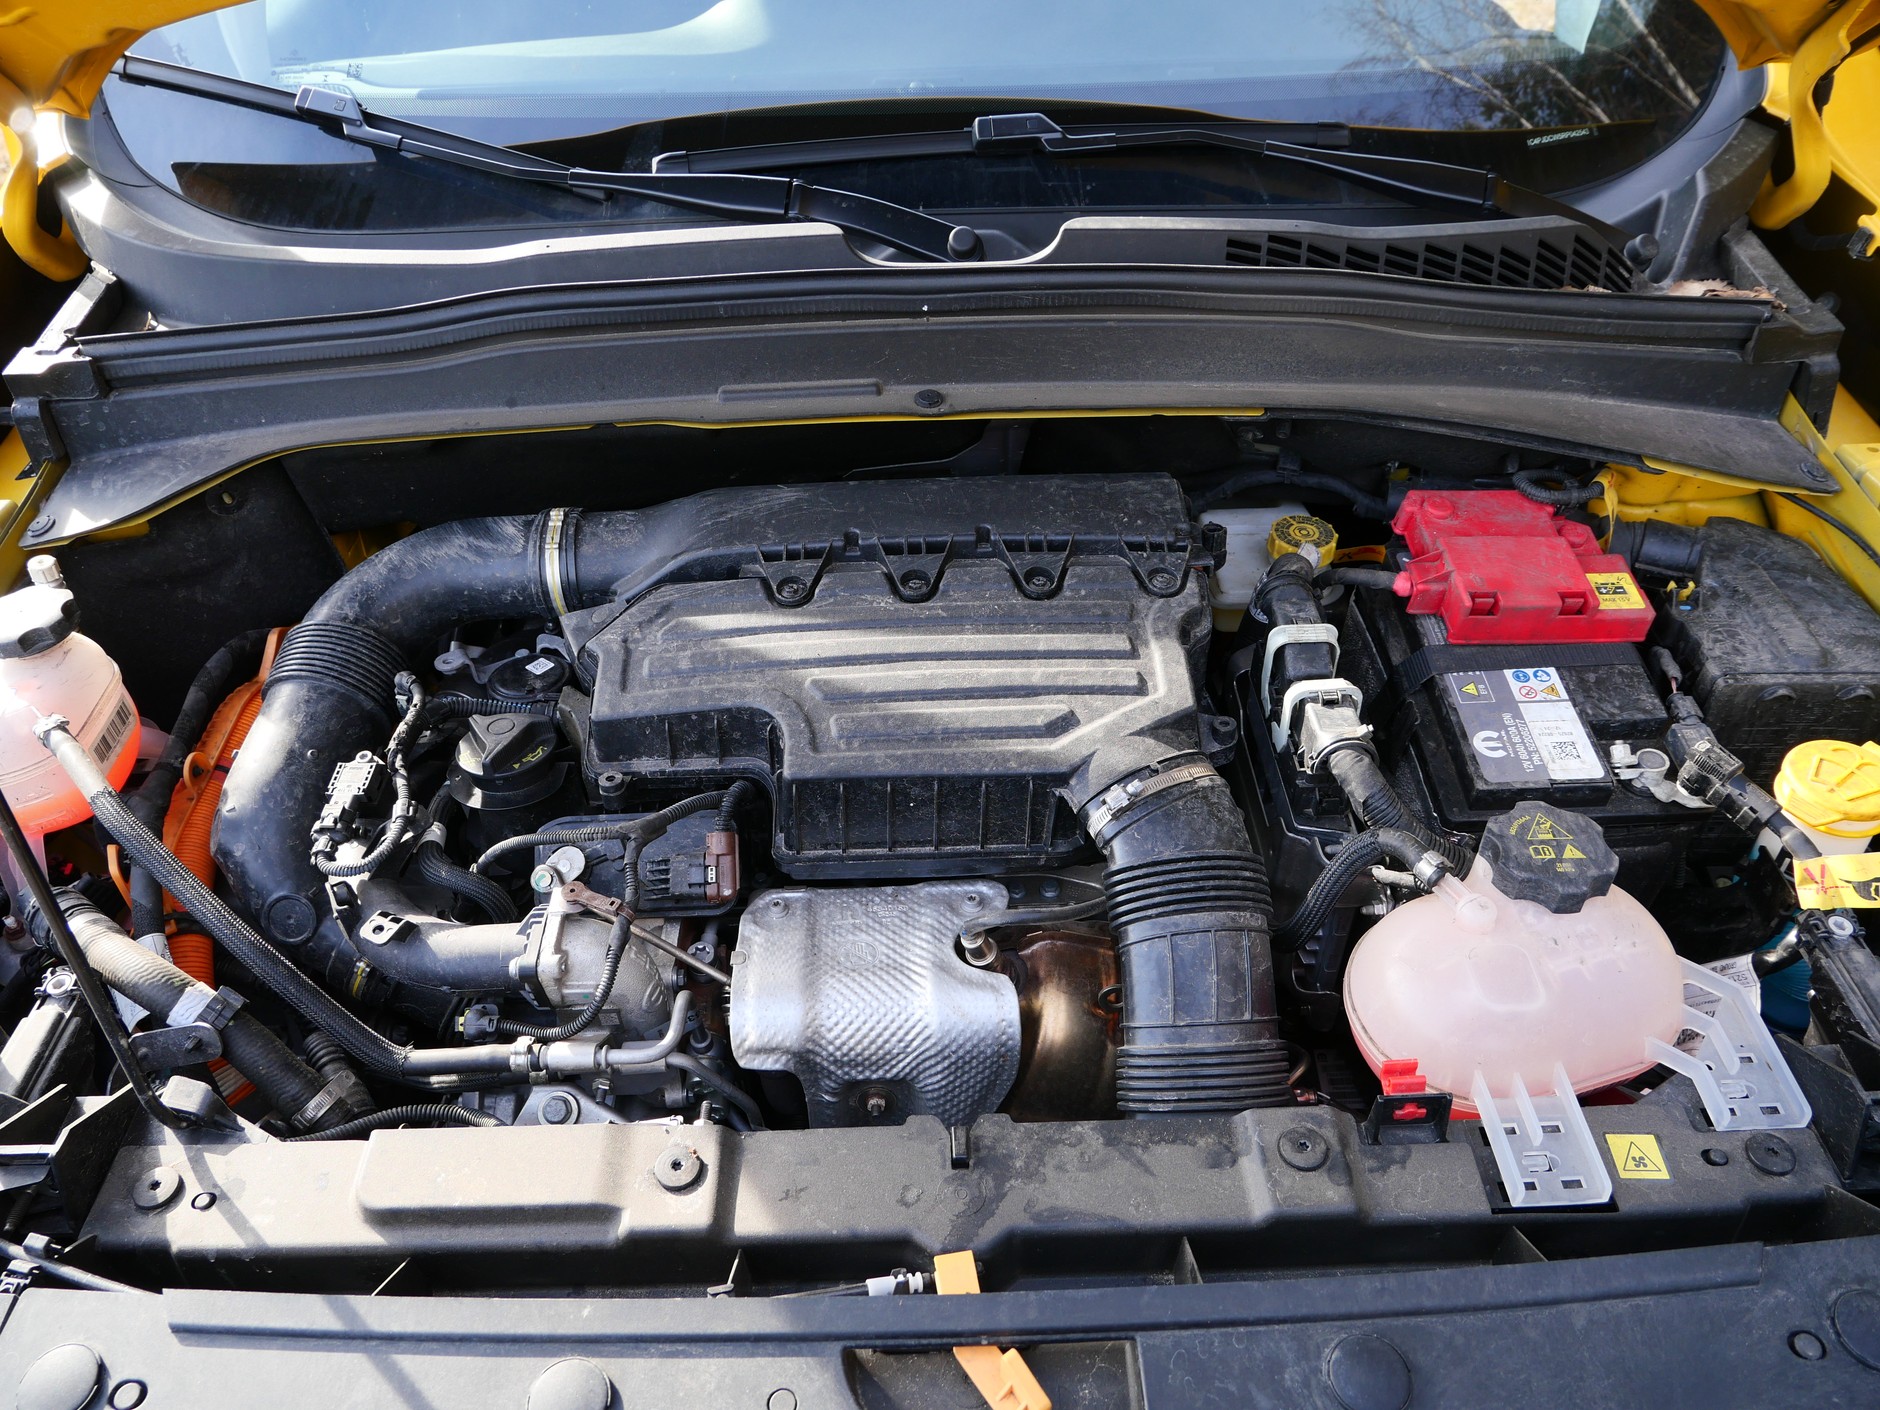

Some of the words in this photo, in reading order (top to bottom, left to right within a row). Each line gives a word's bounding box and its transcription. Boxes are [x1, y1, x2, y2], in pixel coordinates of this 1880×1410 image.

[1501, 712, 1516, 726] (EN)
[1515, 743, 1529, 760] 60Ah
[1530, 751, 1543, 765] PN:
[1521, 760, 1535, 773] 12V
